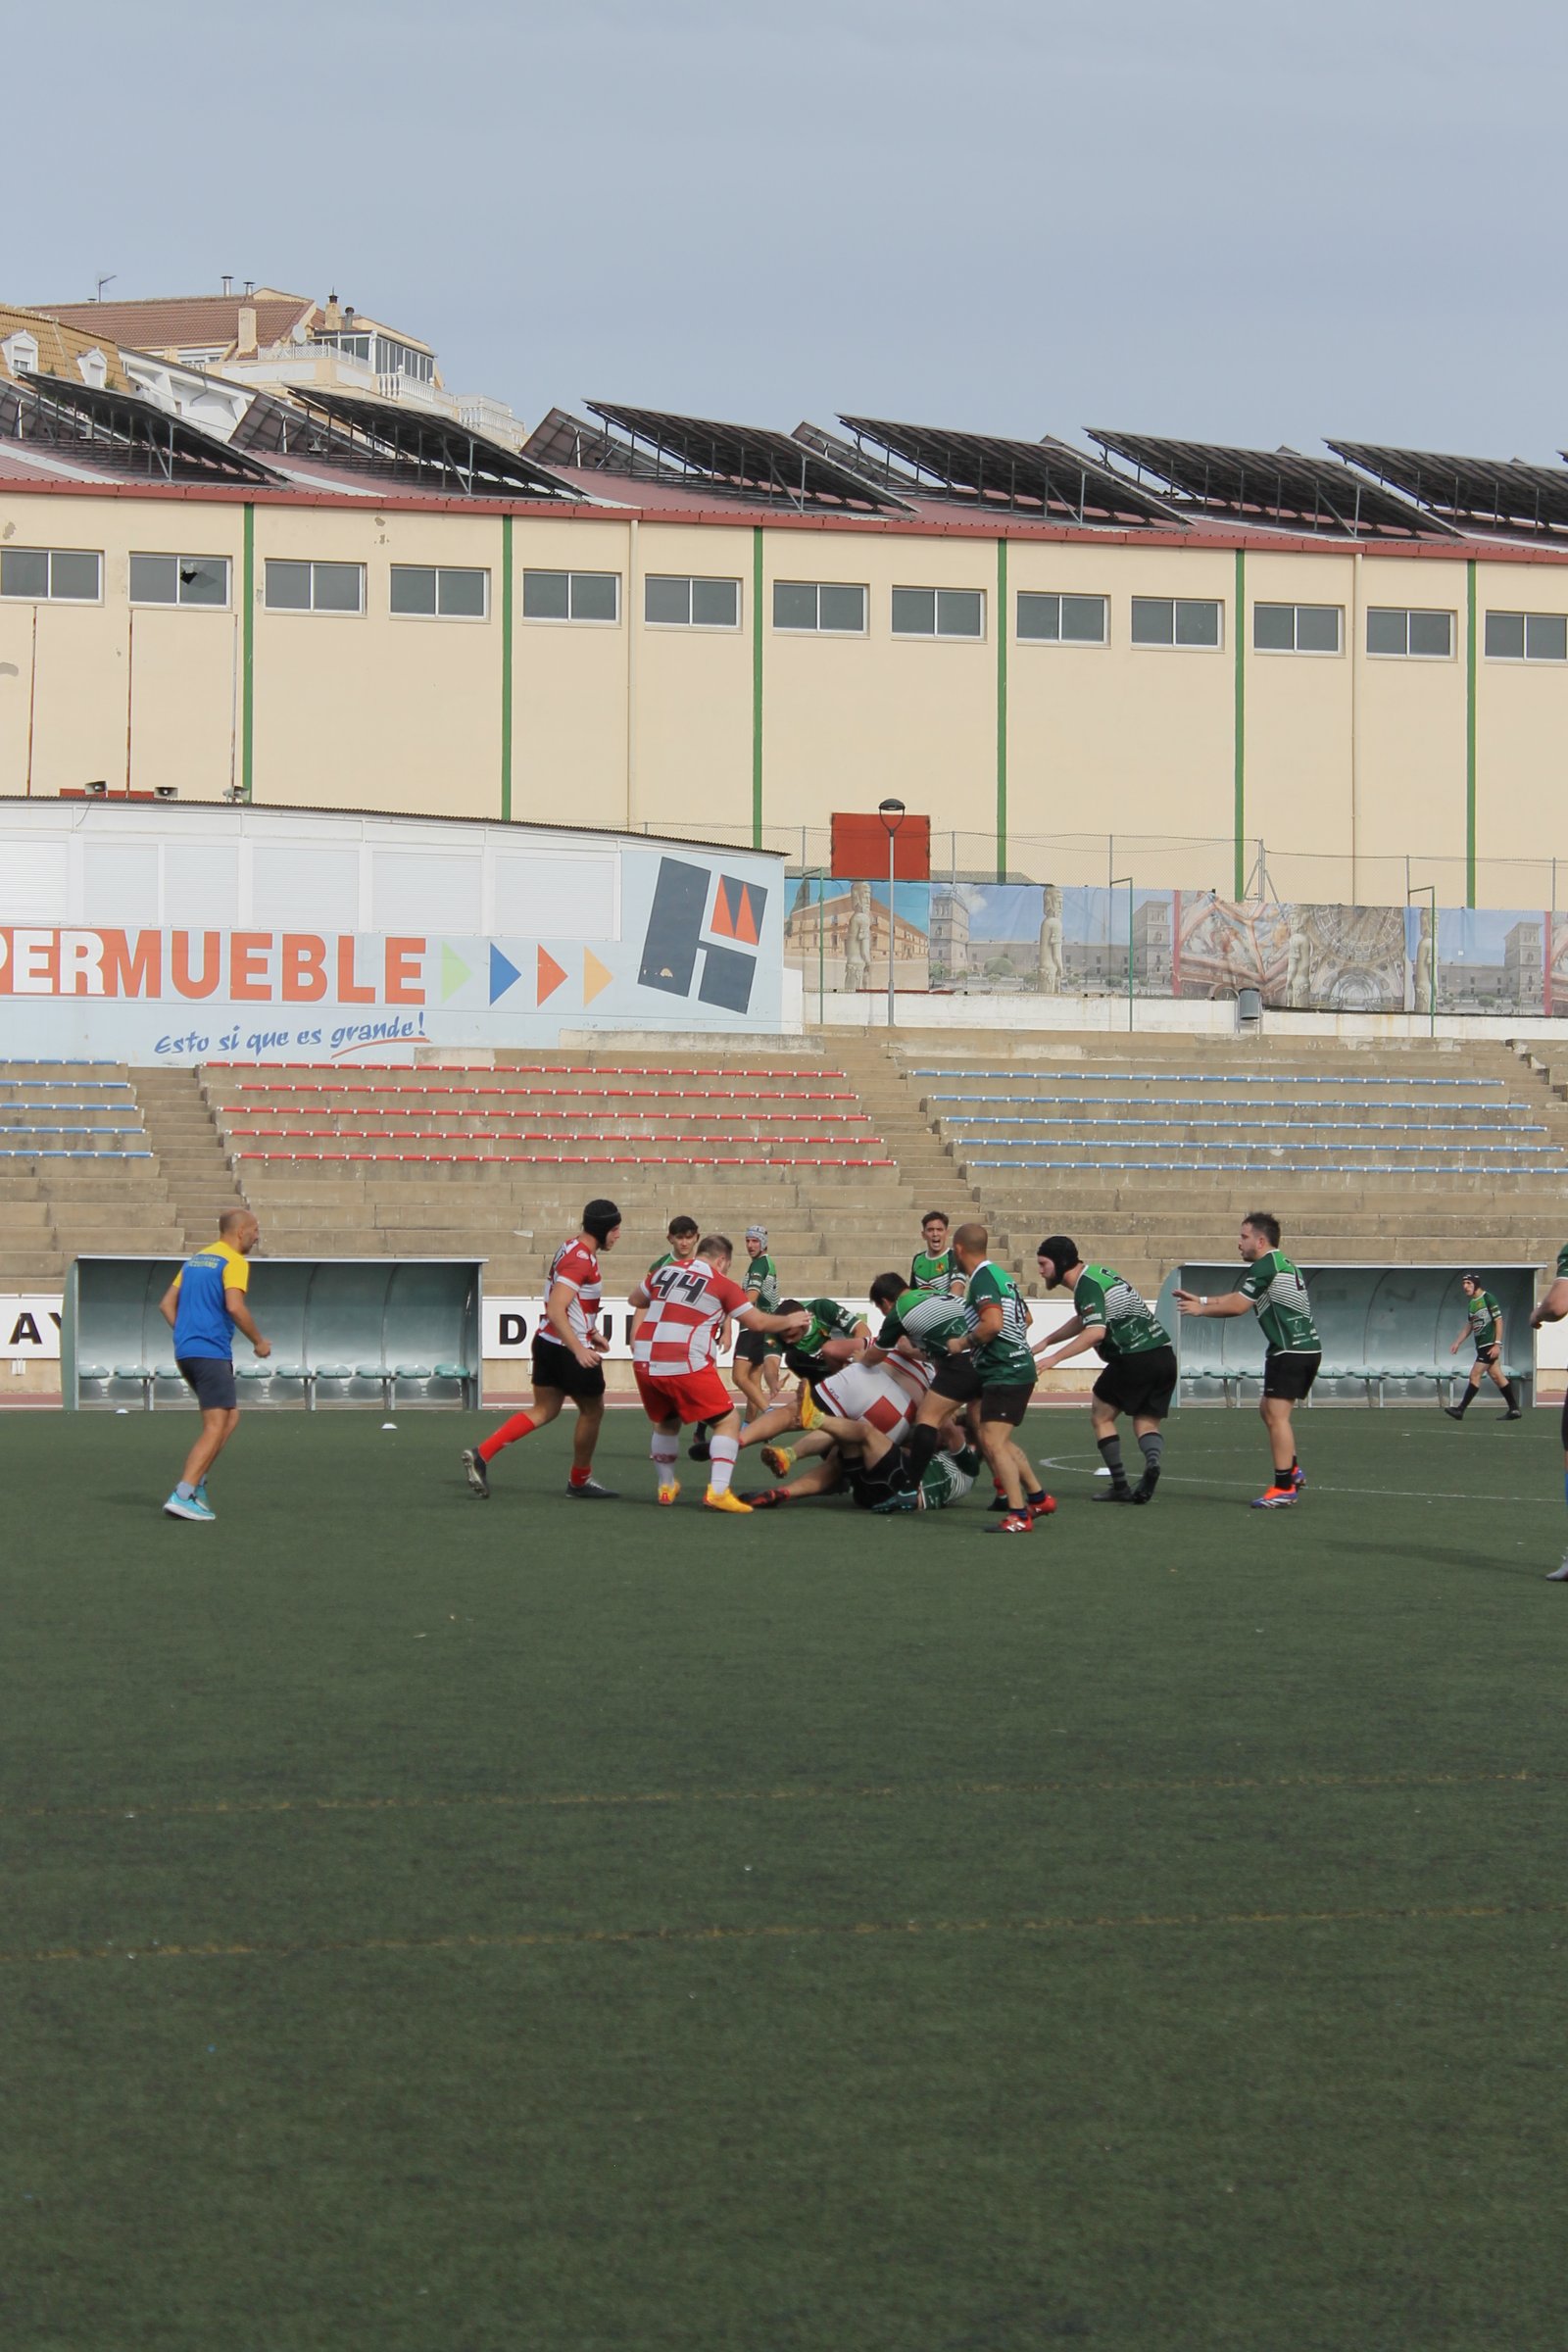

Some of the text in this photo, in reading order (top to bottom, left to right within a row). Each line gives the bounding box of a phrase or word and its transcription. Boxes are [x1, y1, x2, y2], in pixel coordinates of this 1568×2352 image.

[0, 929, 426, 1005] ERMUEBLE
[154, 1030, 210, 1054] Esto
[246, 1030, 289, 1056] que
[297, 1028, 321, 1045] es
[330, 1011, 425, 1049] grande!
[652, 1269, 709, 1305] 44
